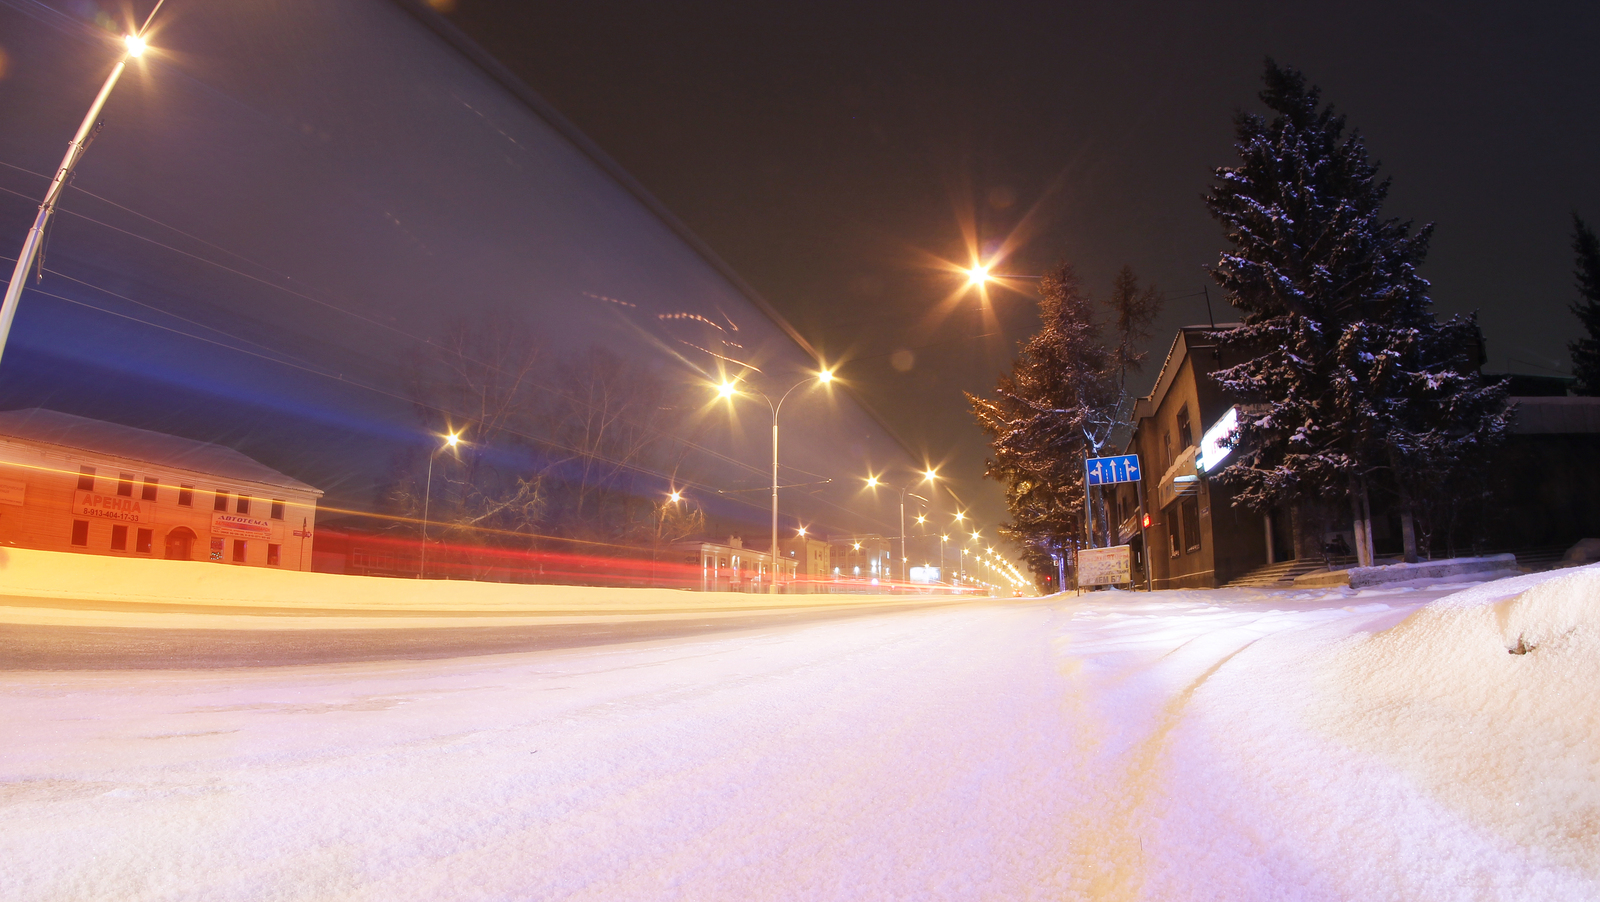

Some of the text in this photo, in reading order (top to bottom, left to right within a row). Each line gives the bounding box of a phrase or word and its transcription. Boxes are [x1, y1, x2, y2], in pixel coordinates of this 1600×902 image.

[82, 494, 141, 513] АРЕНДА
[83, 508, 139, 521] 8-913-404-17-33
[218, 515, 269, 526] АВТОТЕМА
